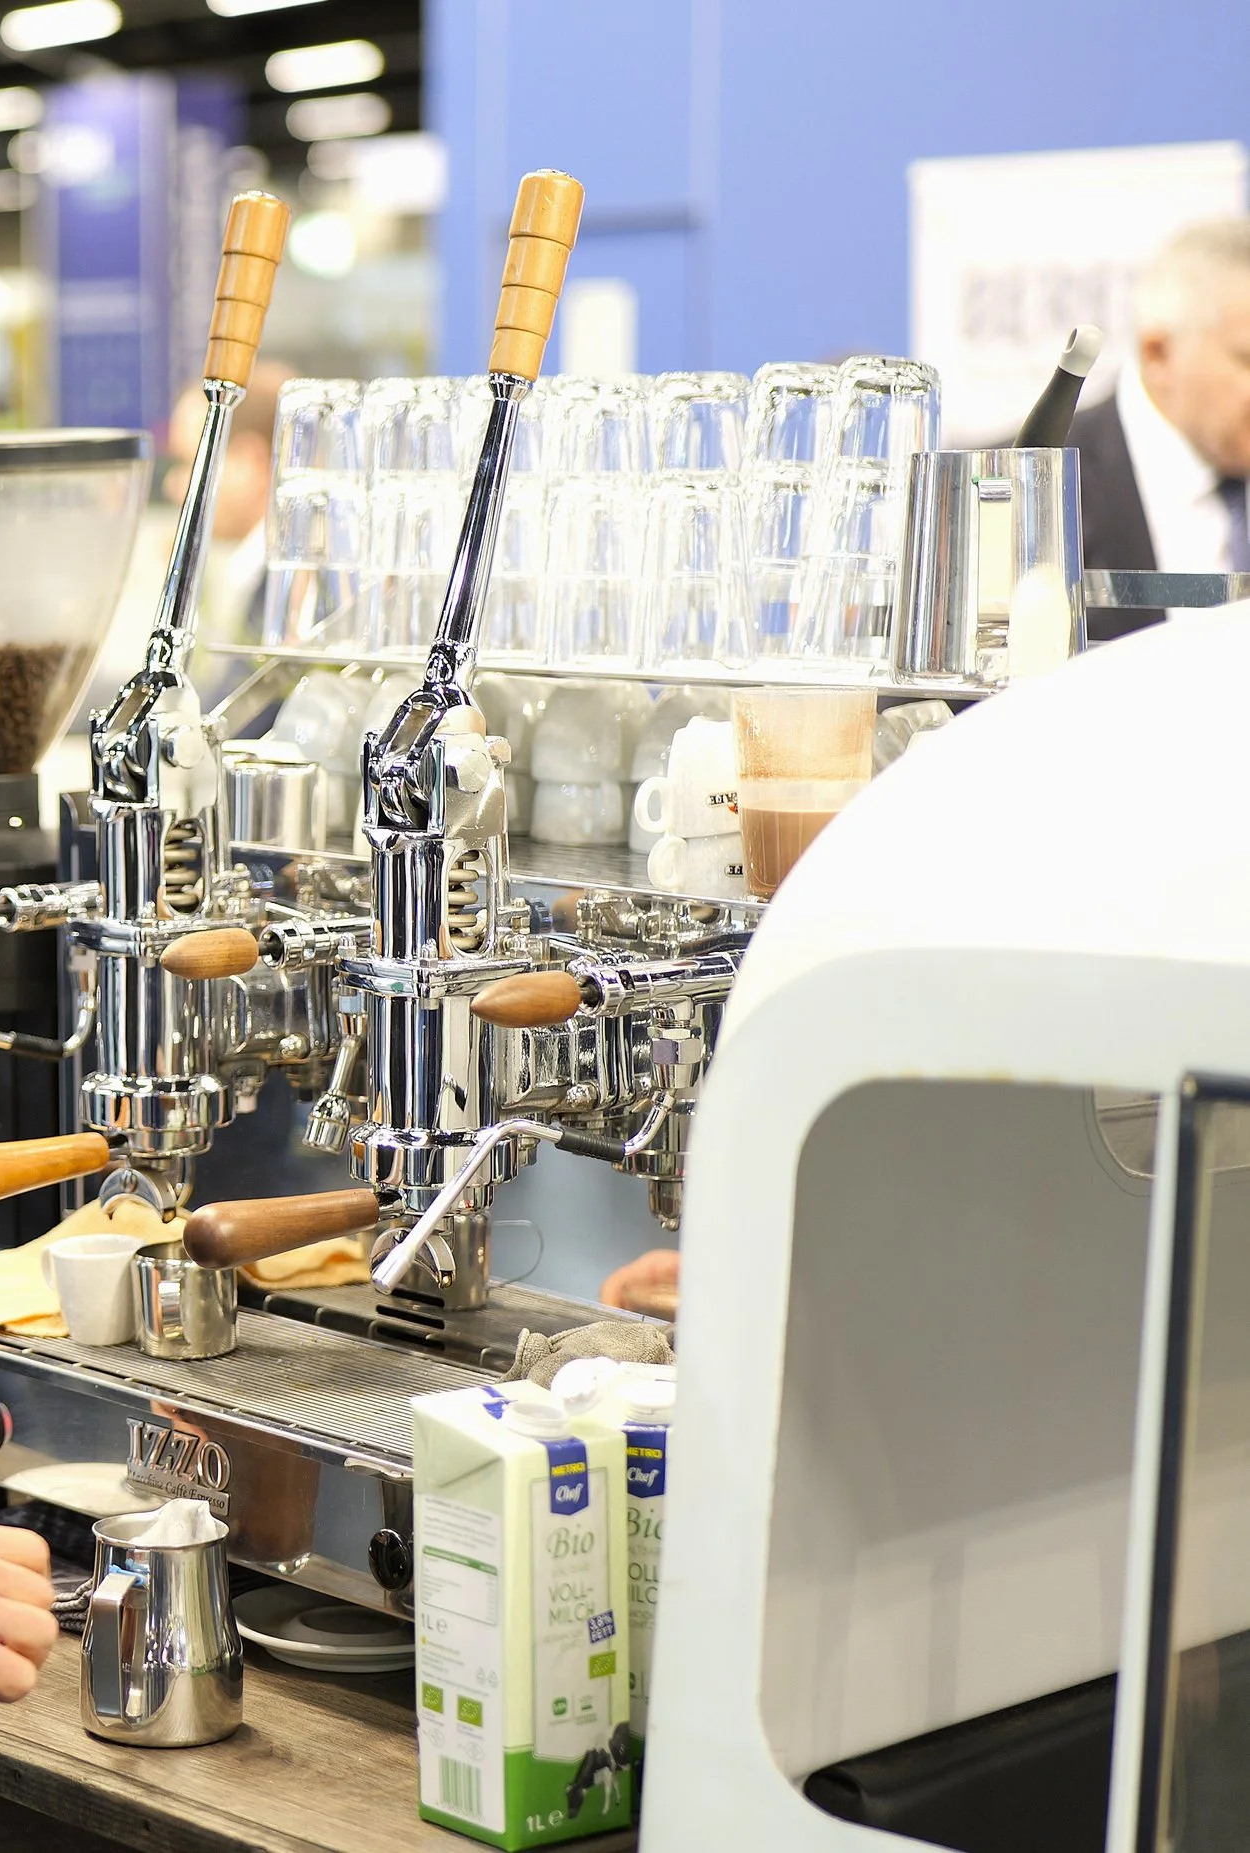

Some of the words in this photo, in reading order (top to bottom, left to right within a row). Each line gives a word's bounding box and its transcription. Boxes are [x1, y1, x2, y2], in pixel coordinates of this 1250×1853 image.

[728, 864, 743, 876] FE
[126, 1416, 231, 1492] IZZO
[551, 1461, 586, 1477] METRO
[626, 1466, 660, 1488] Chef
[555, 1483, 584, 1503] Chef
[546, 1523, 595, 1559] Bio
[628, 1562, 658, 1582] OLL
[627, 1583, 658, 1604] ILC
[548, 1602, 595, 1627] MILCH
[526, 1813, 546, 1832] 1L
